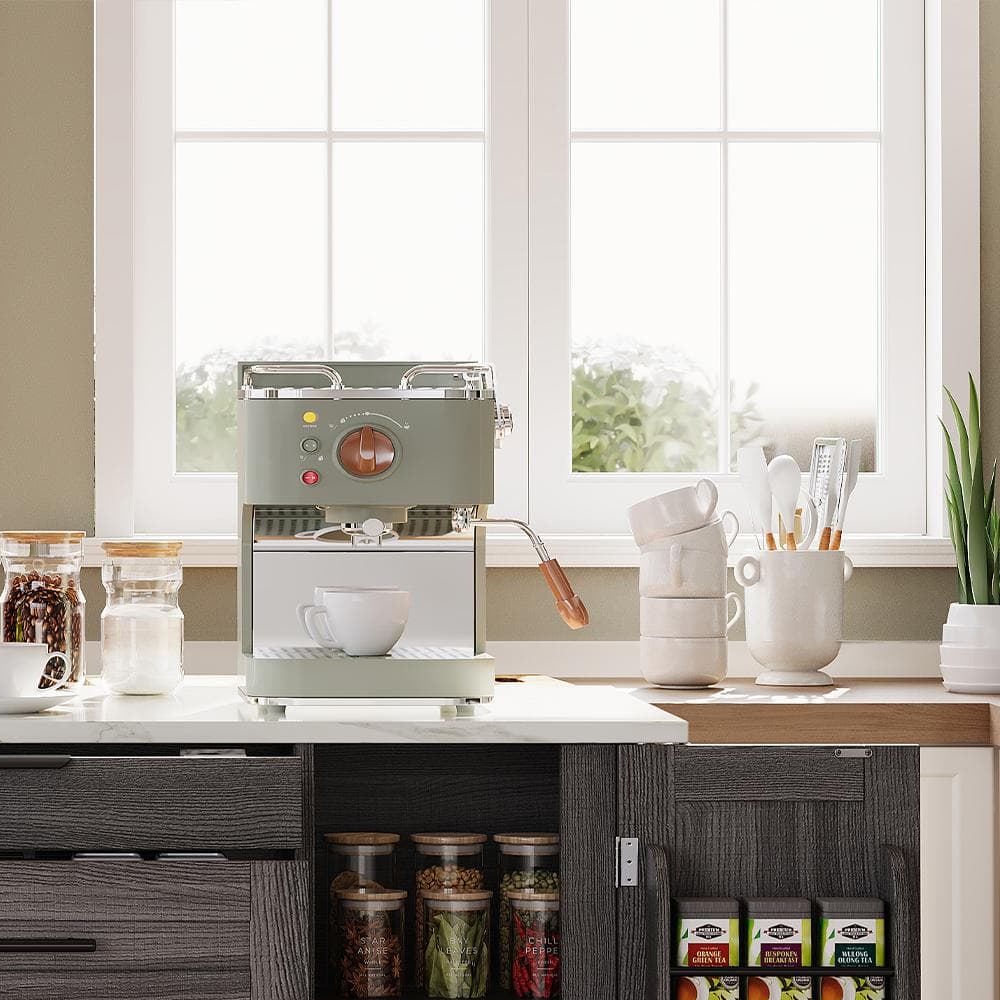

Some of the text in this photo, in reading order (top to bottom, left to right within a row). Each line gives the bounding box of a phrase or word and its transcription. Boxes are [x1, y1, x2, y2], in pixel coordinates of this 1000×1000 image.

[360, 937, 386, 945] STAR
[357, 947, 389, 955] ANISE
[438, 947, 479, 955] LEAVES
